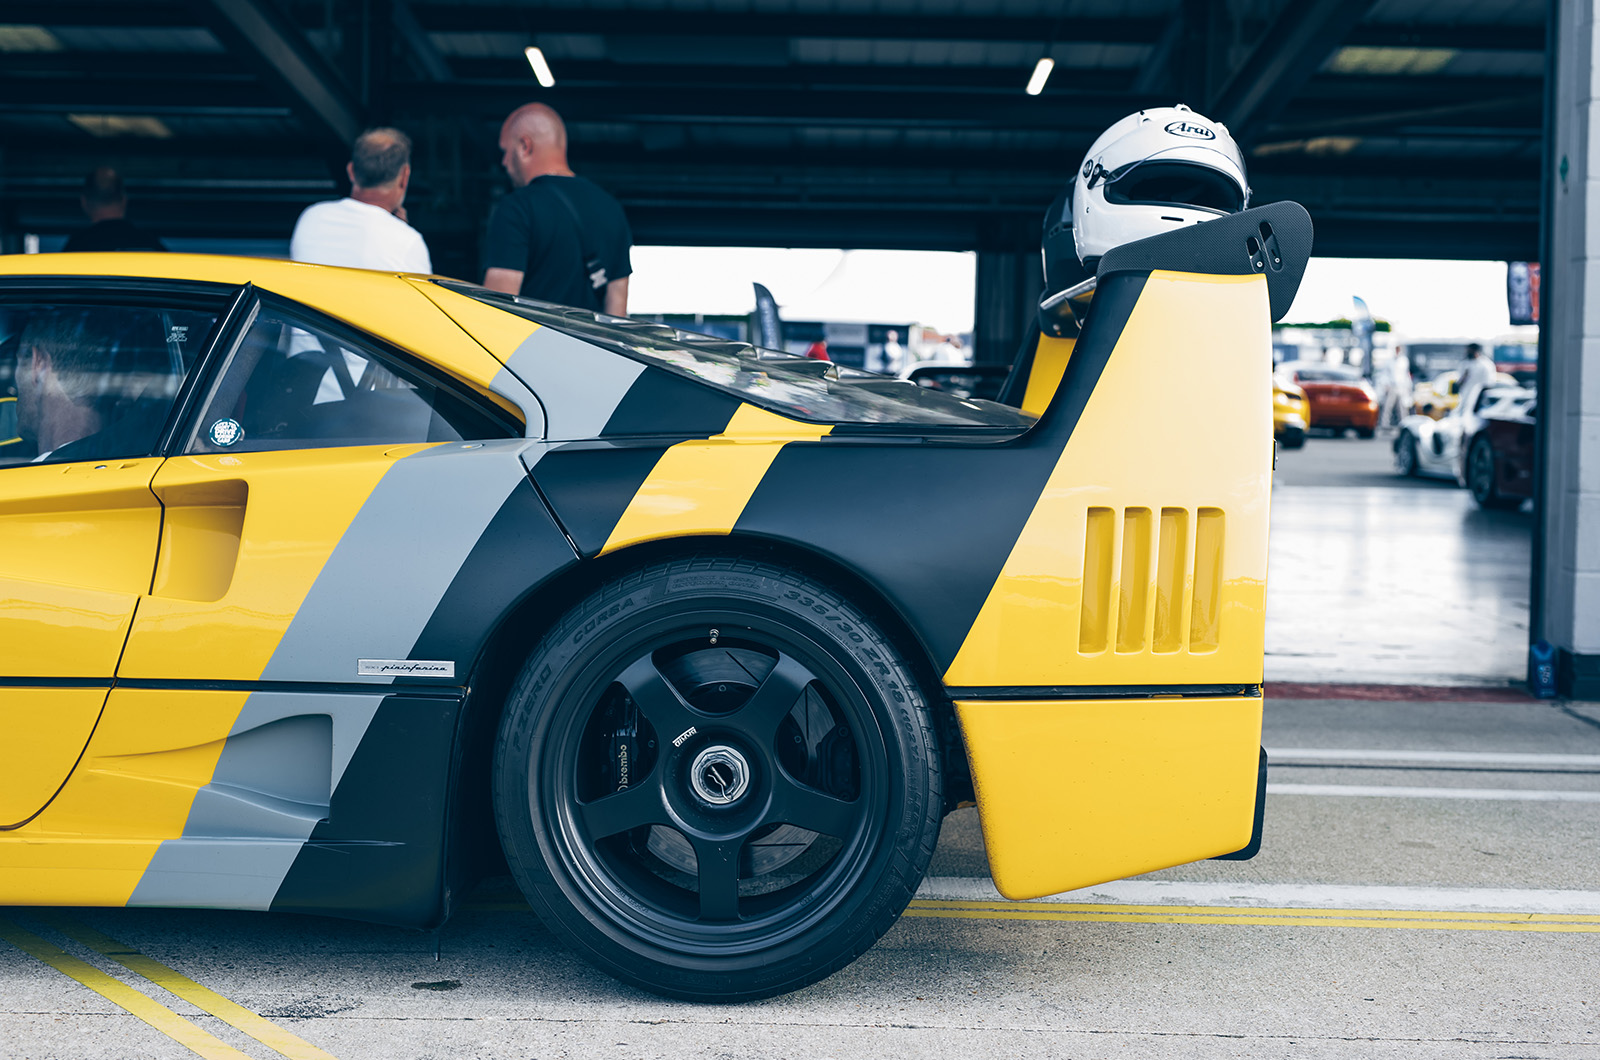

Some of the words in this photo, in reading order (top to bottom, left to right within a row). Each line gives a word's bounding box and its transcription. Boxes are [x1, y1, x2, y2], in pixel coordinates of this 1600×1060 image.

[1168, 122, 1210, 137] Arai
[573, 597, 634, 645] CORSA
[381, 663, 447, 672] pininfarina
[783, 590, 864, 643] 335/30
[862, 647, 891, 676] ZR
[889, 680, 905, 703] 18
[517, 663, 552, 734] ZERO
[617, 744, 628, 784] brembo
